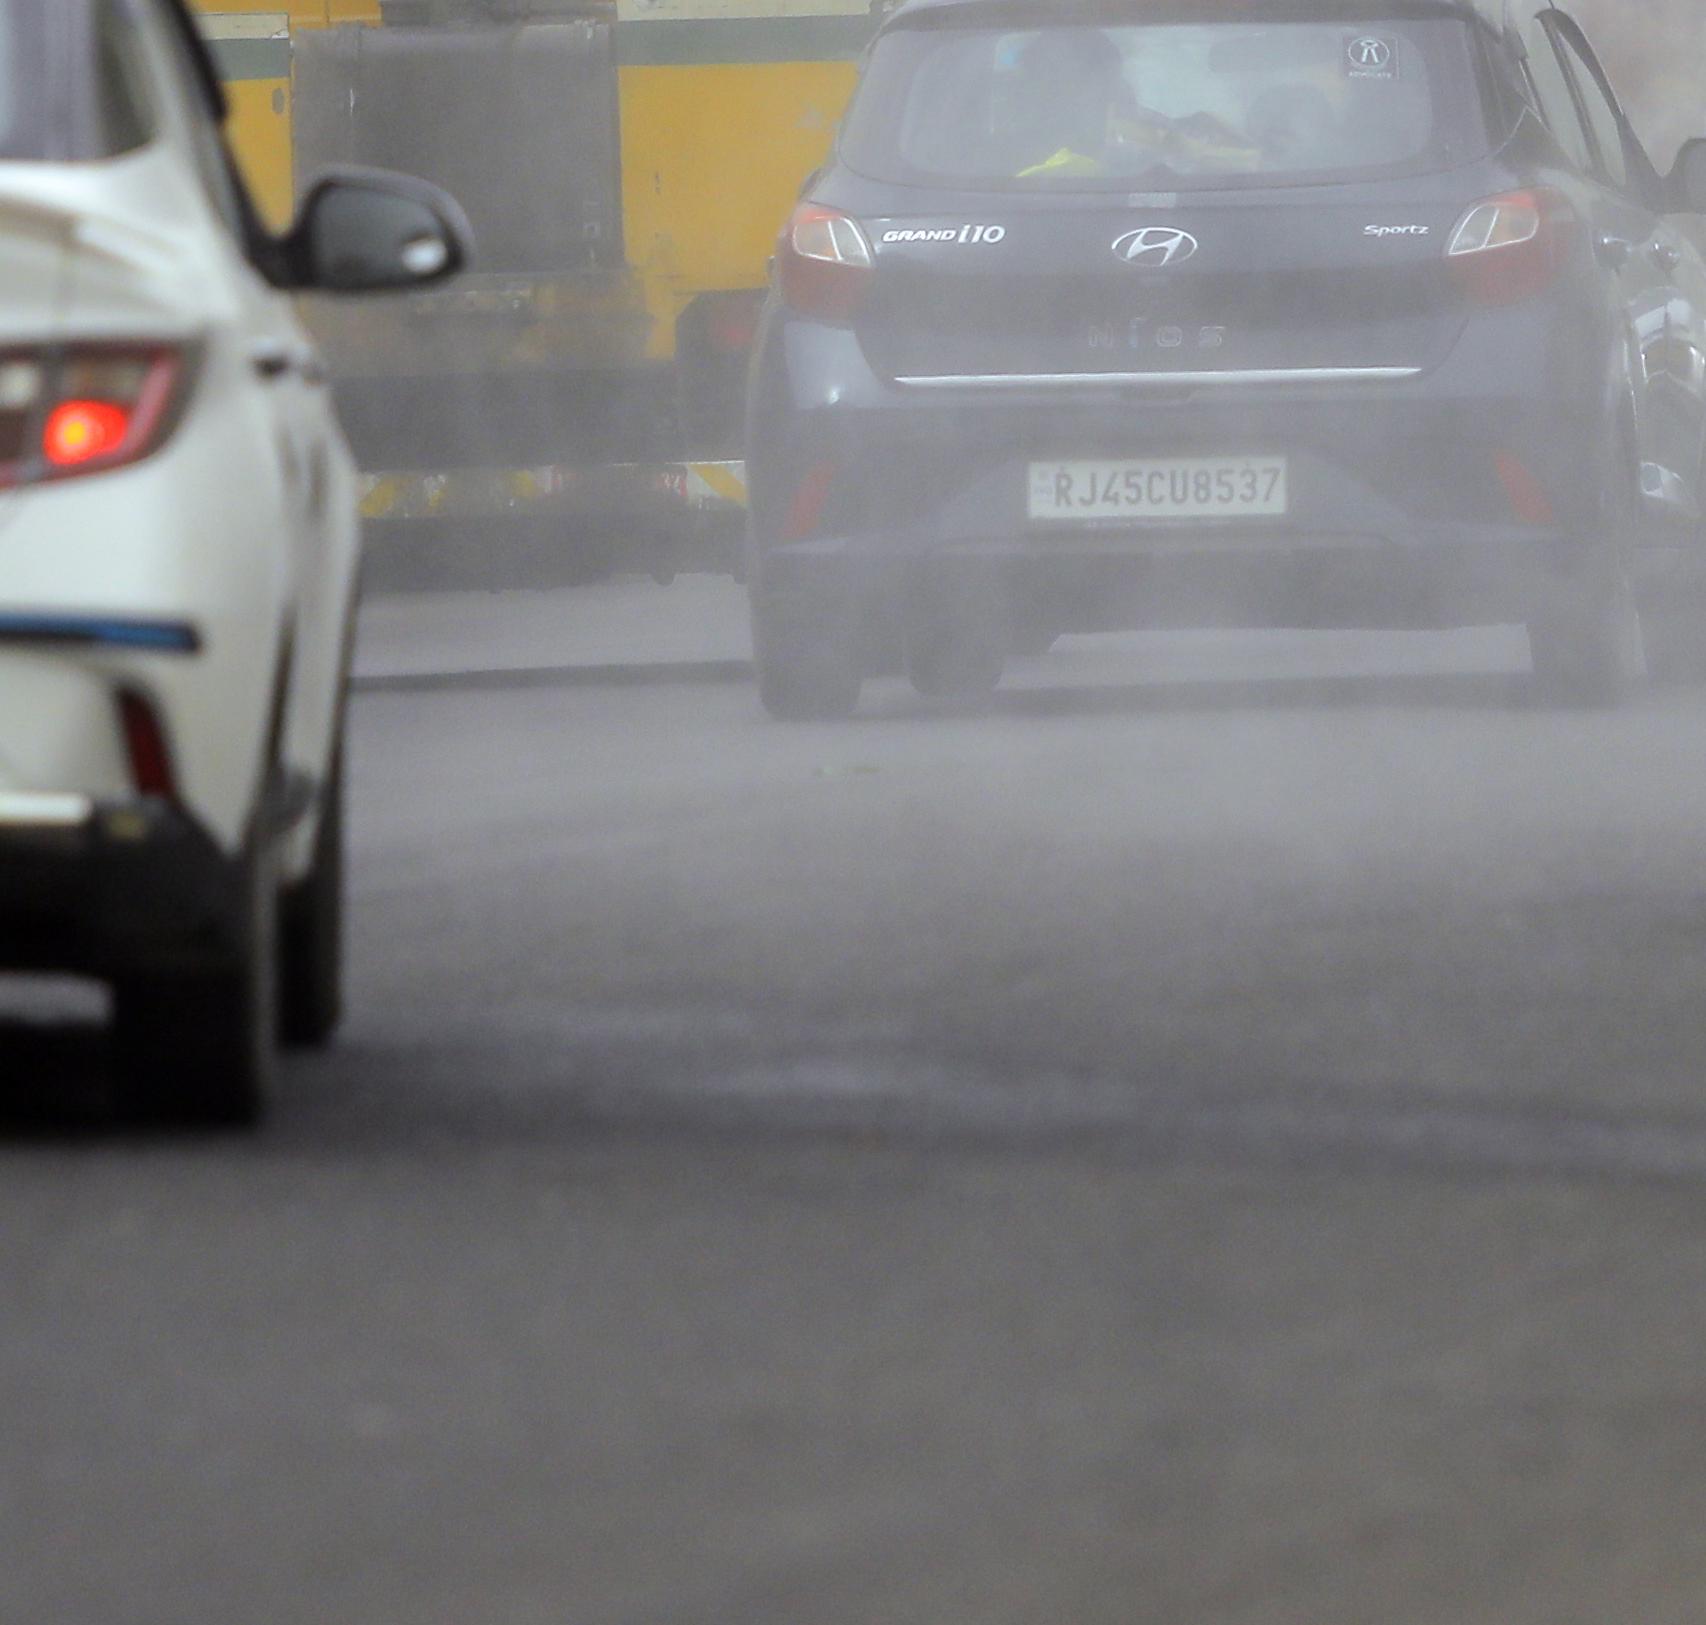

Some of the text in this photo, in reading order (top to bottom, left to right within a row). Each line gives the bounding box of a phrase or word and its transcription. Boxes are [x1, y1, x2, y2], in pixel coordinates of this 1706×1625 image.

[882, 223, 1006, 244] GRAND i10
[1363, 224, 1430, 237] Sportz
[1053, 467, 1282, 508] RJ45CU8537
